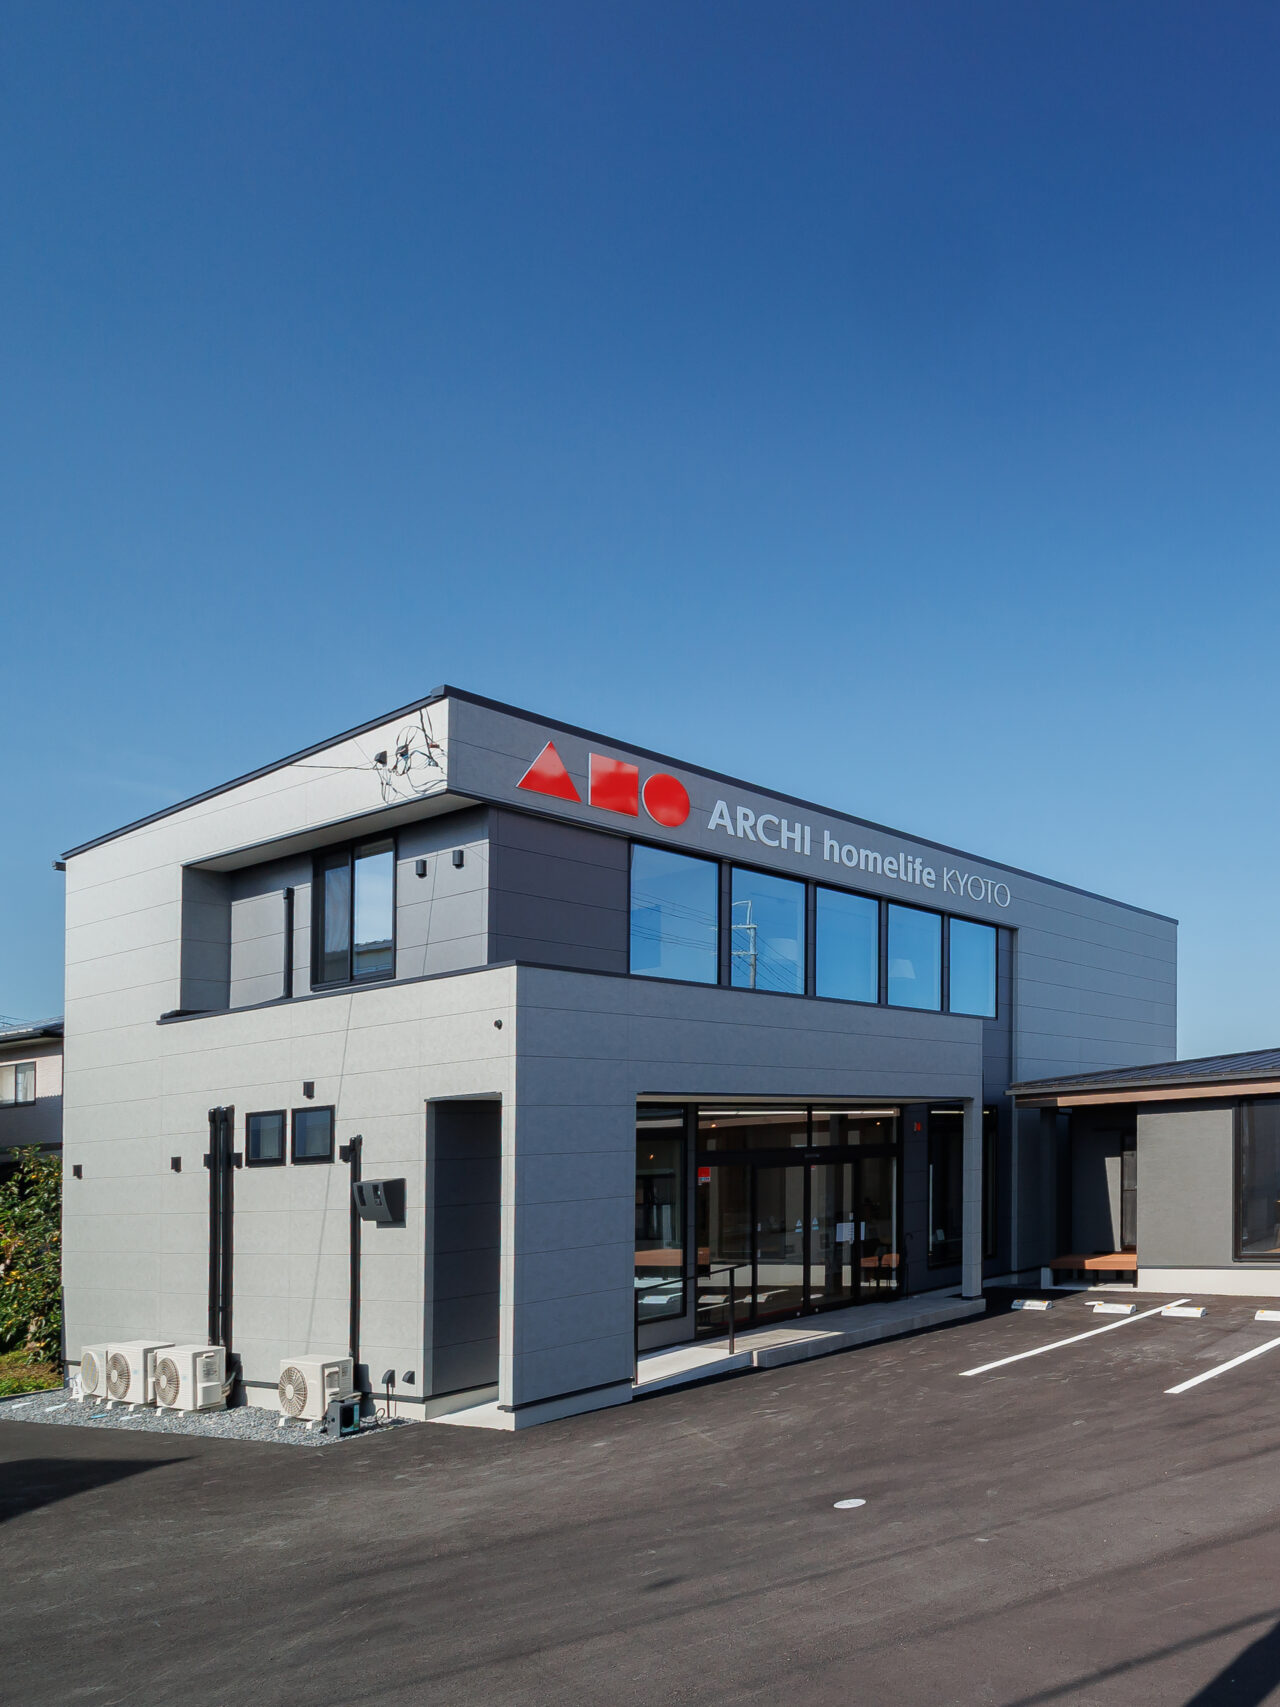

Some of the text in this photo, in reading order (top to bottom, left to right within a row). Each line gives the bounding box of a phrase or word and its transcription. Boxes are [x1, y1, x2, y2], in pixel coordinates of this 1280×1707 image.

[707, 799, 1011, 908] ARCHI homelife KYOTO
